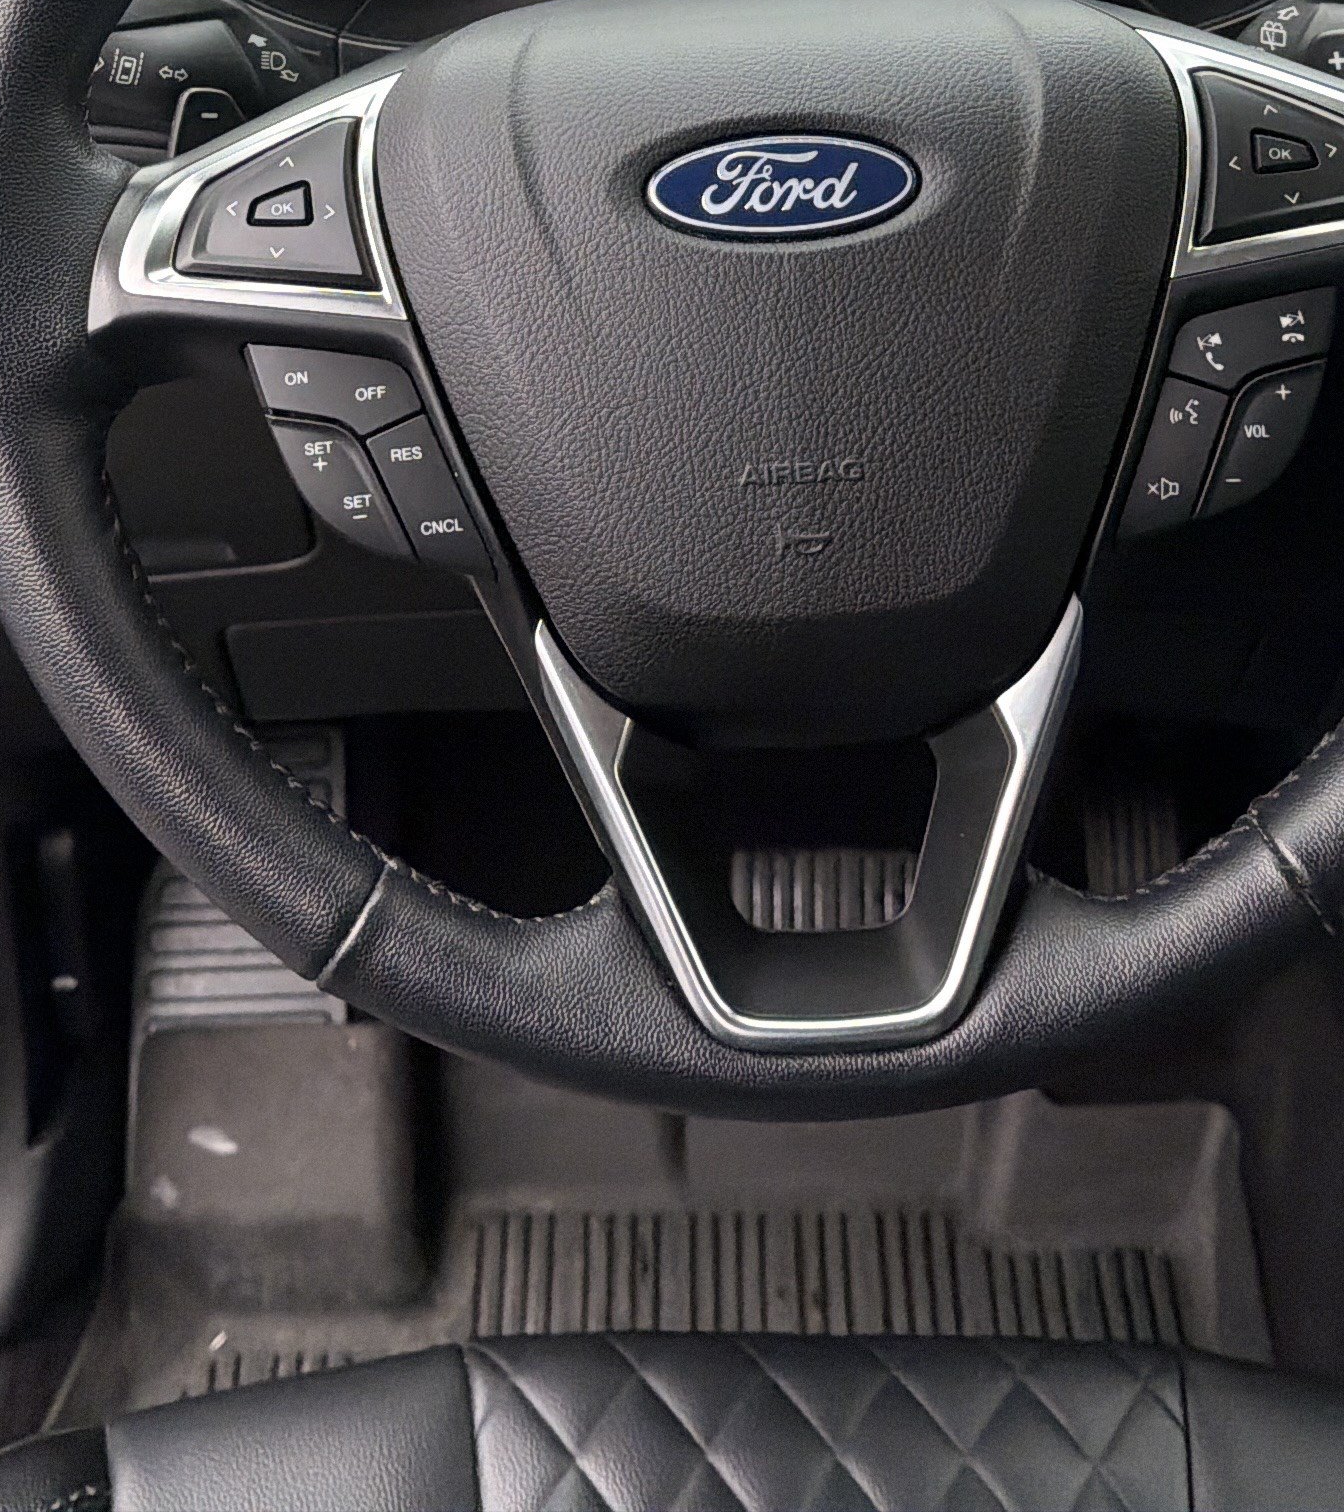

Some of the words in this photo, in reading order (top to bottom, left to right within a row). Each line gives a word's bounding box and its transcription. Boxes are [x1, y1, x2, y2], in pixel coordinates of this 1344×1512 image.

[1268, 148, 1291, 161] OK
[701, 150, 859, 216] Ford
[270, 202, 294, 216] OK
[285, 371, 308, 386] ON
[355, 386, 386, 402] OFF
[1244, 424, 1270, 438] VOL
[304, 441, 333, 456] SET
[391, 446, 422, 462] RES
[739, 459, 864, 486] AIRBAG
[343, 494, 372, 510] SET
[420, 519, 464, 535] CNCL
